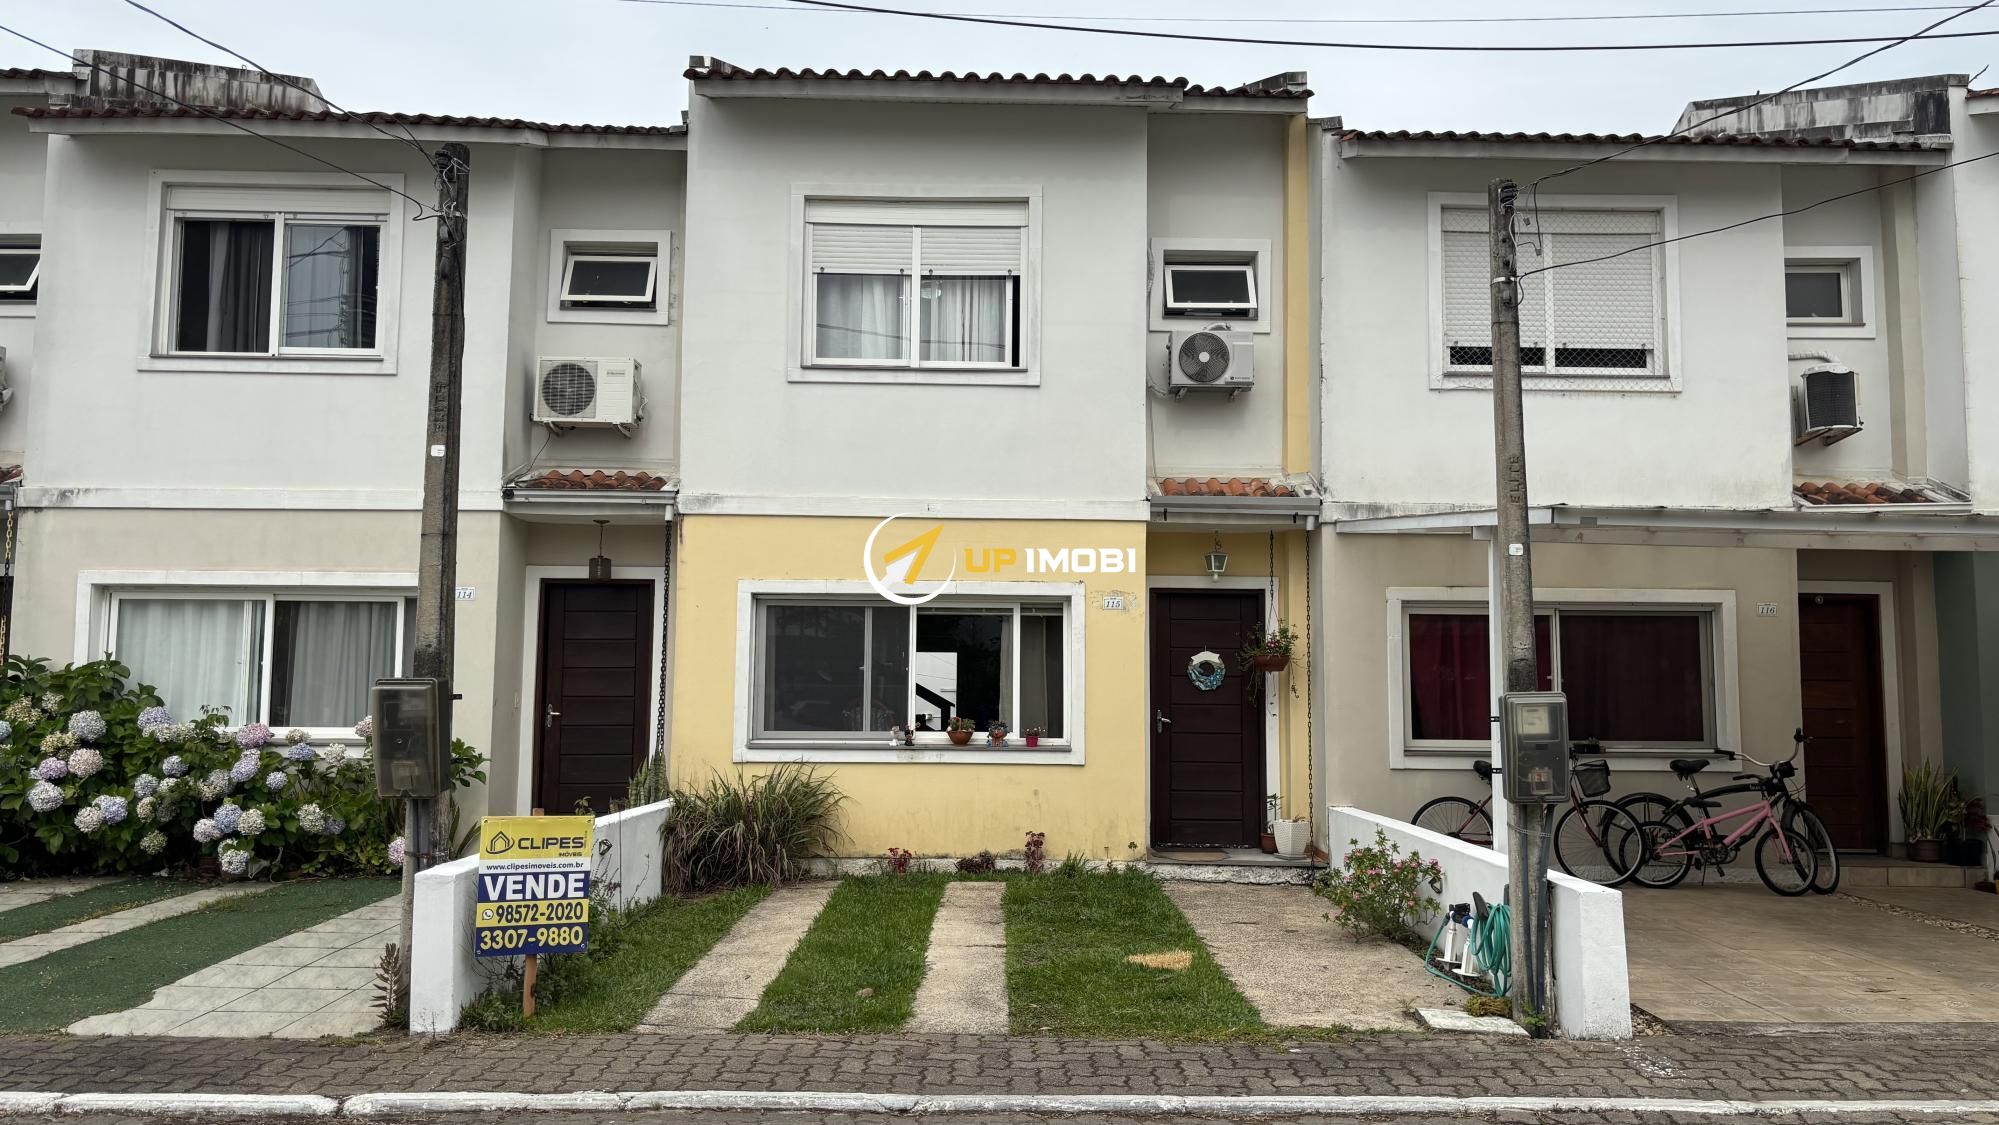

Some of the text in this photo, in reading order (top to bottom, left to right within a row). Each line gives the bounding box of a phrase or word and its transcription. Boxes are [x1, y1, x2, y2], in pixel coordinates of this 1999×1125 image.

[457, 591, 472, 599] 114
[518, 837, 584, 850] CLIPES
[486, 862, 584, 871] www.clipesimoveis.com.br
[484, 874, 585, 901] VENDE
[496, 902, 584, 924] 98572-2020
[480, 926, 584, 950] 3307-9880
